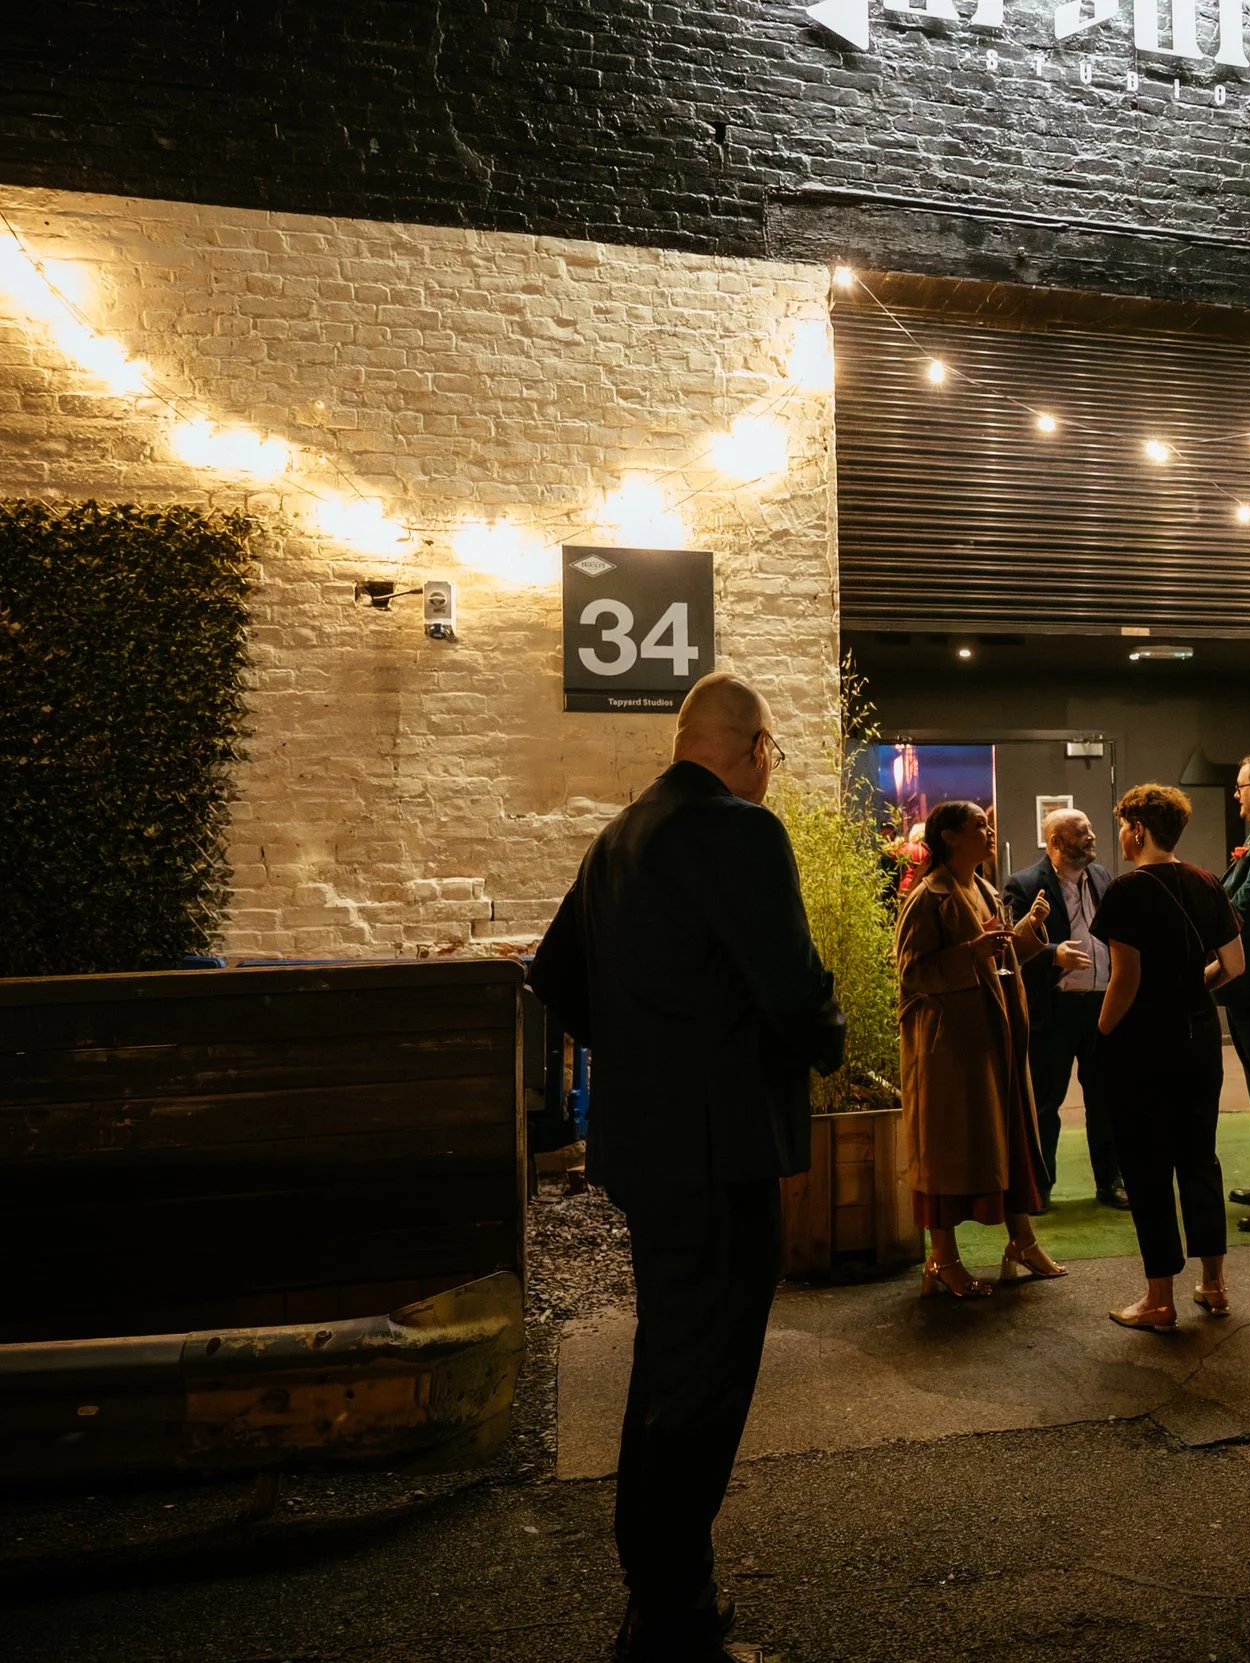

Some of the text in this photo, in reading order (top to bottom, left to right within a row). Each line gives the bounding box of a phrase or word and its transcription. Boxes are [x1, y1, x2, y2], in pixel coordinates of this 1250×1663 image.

[578, 598, 699, 677] 34
[608, 697, 673, 708] Tapyard Studios
